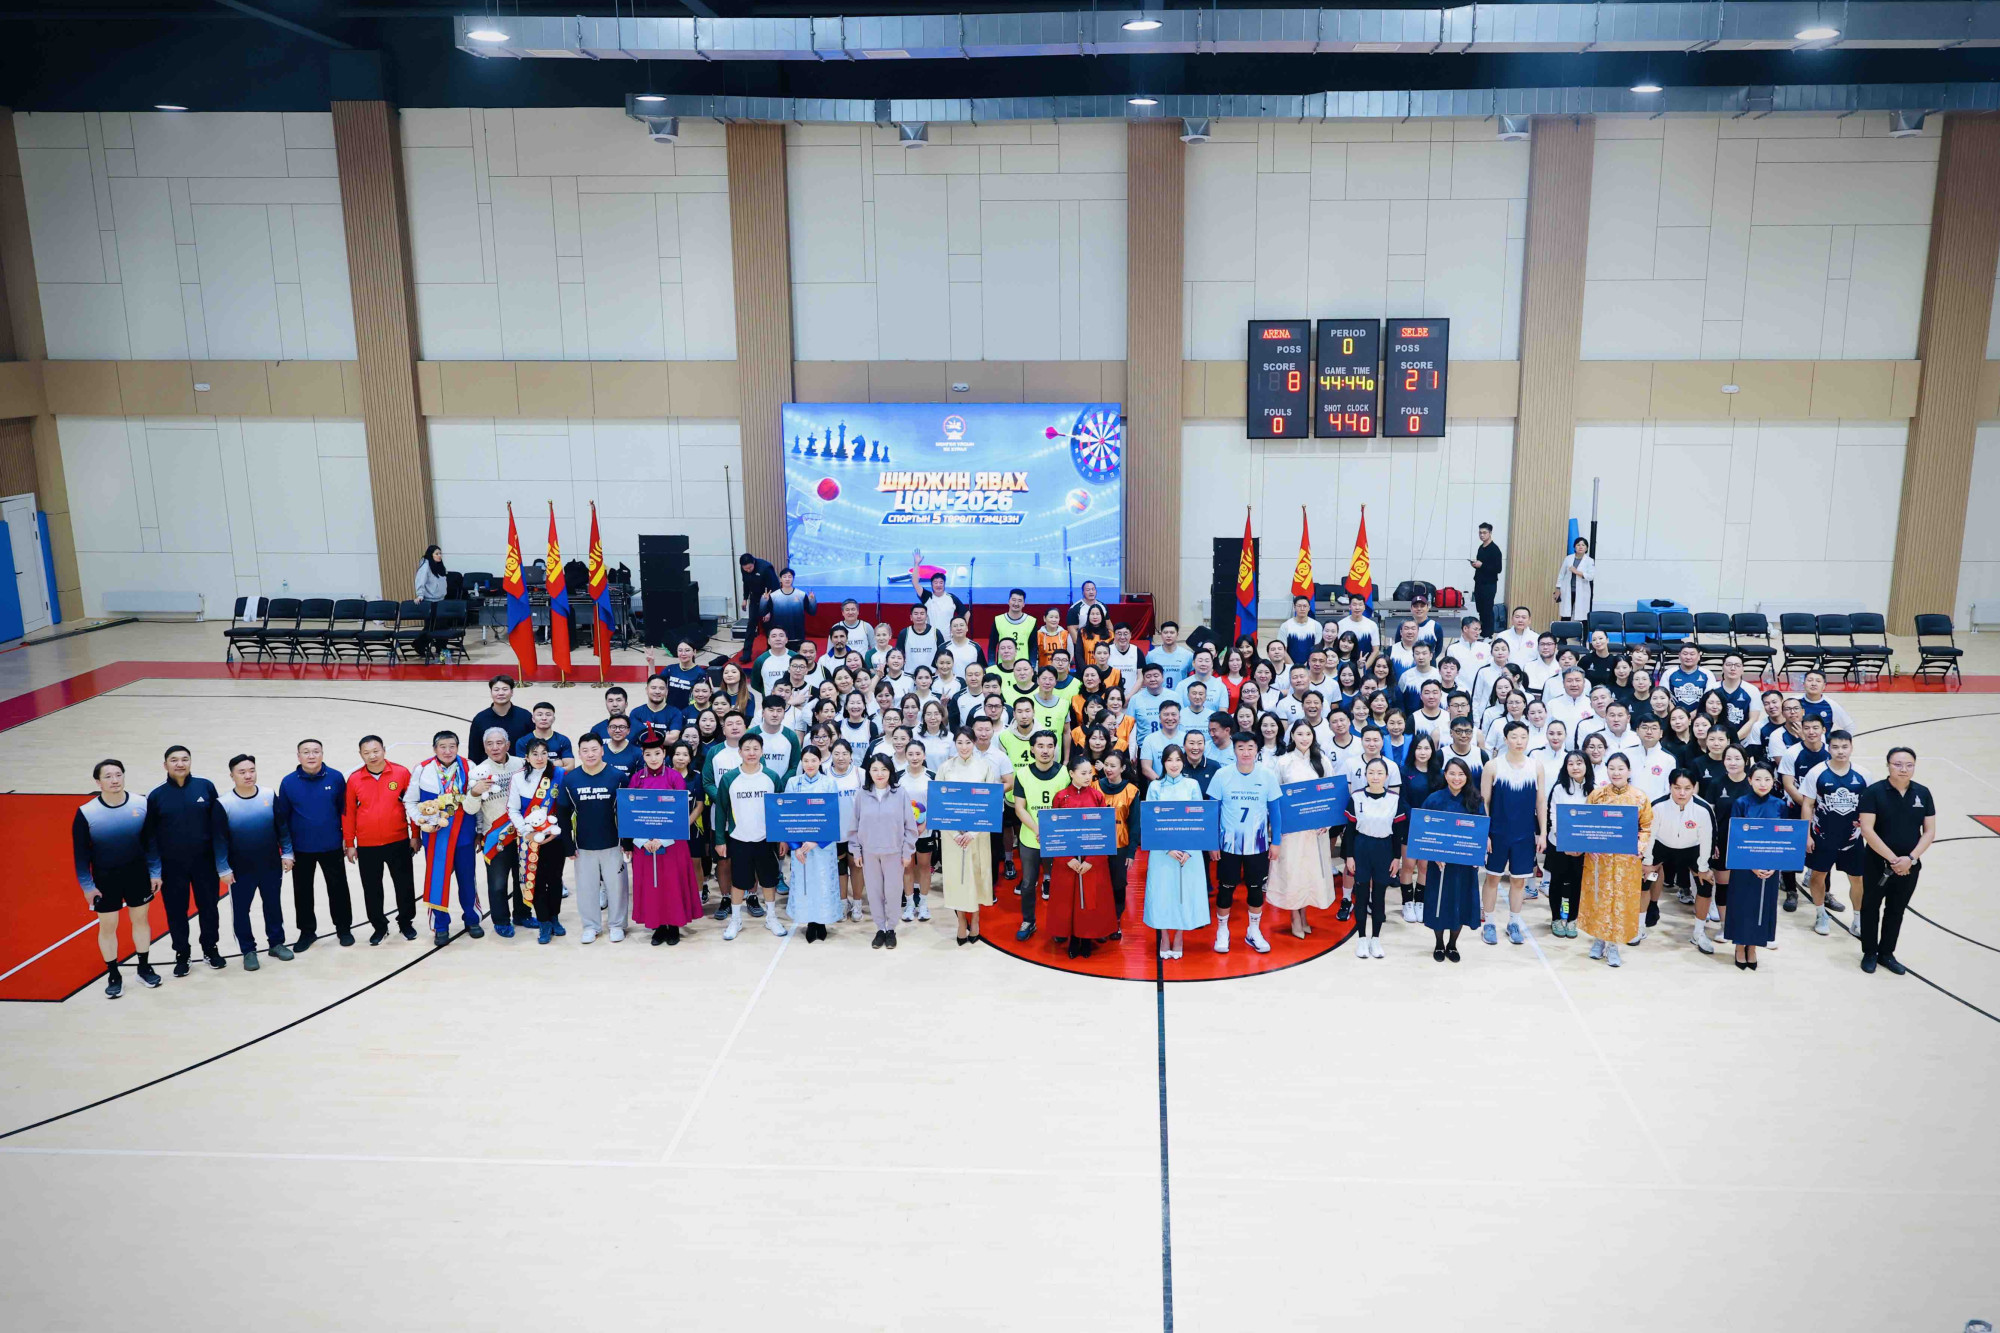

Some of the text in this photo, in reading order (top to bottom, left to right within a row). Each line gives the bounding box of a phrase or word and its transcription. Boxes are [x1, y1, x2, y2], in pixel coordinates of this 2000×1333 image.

[1262, 329, 1291, 339] ARENA
[1330, 329, 1367, 337] PERIOD
[1401, 327, 1429, 338] SELBE
[1276, 345, 1302, 354] POSS
[1343, 338, 1354, 355] 0
[1395, 344, 1420, 352] POSS
[1263, 363, 1296, 371] SCORE
[1400, 361, 1433, 369] SCORE
[1325, 367, 1370, 375] GAME TIME
[1287, 371, 1301, 392] 8
[1324, 404, 1369, 412] SHOT CLOCK
[1401, 407, 1429, 415] FOULS
[1273, 417, 1283, 434] 0
[1409, 416, 1420, 432] 0
[876, 472, 1029, 492] ШИЛЖИН ЯВАХ
[894, 491, 1013, 513] ЦОМ-2026
[888, 513, 1020, 524] СПОРТЫН 5 ТӨРӨЛТ ТЭМЦЭЭН
[1048, 643, 1058, 652] 10
[1290, 705, 1297, 714] 5
[1044, 716, 1052, 727] 5
[1331, 751, 1337, 761] 3
[1355, 768, 1361, 778] 4
[1042, 791, 1050, 803] 6
[1825, 795, 1857, 805] VOLLEYBALL
[1359, 802, 1364, 812] 1
[1240, 807, 1249, 823] 7
